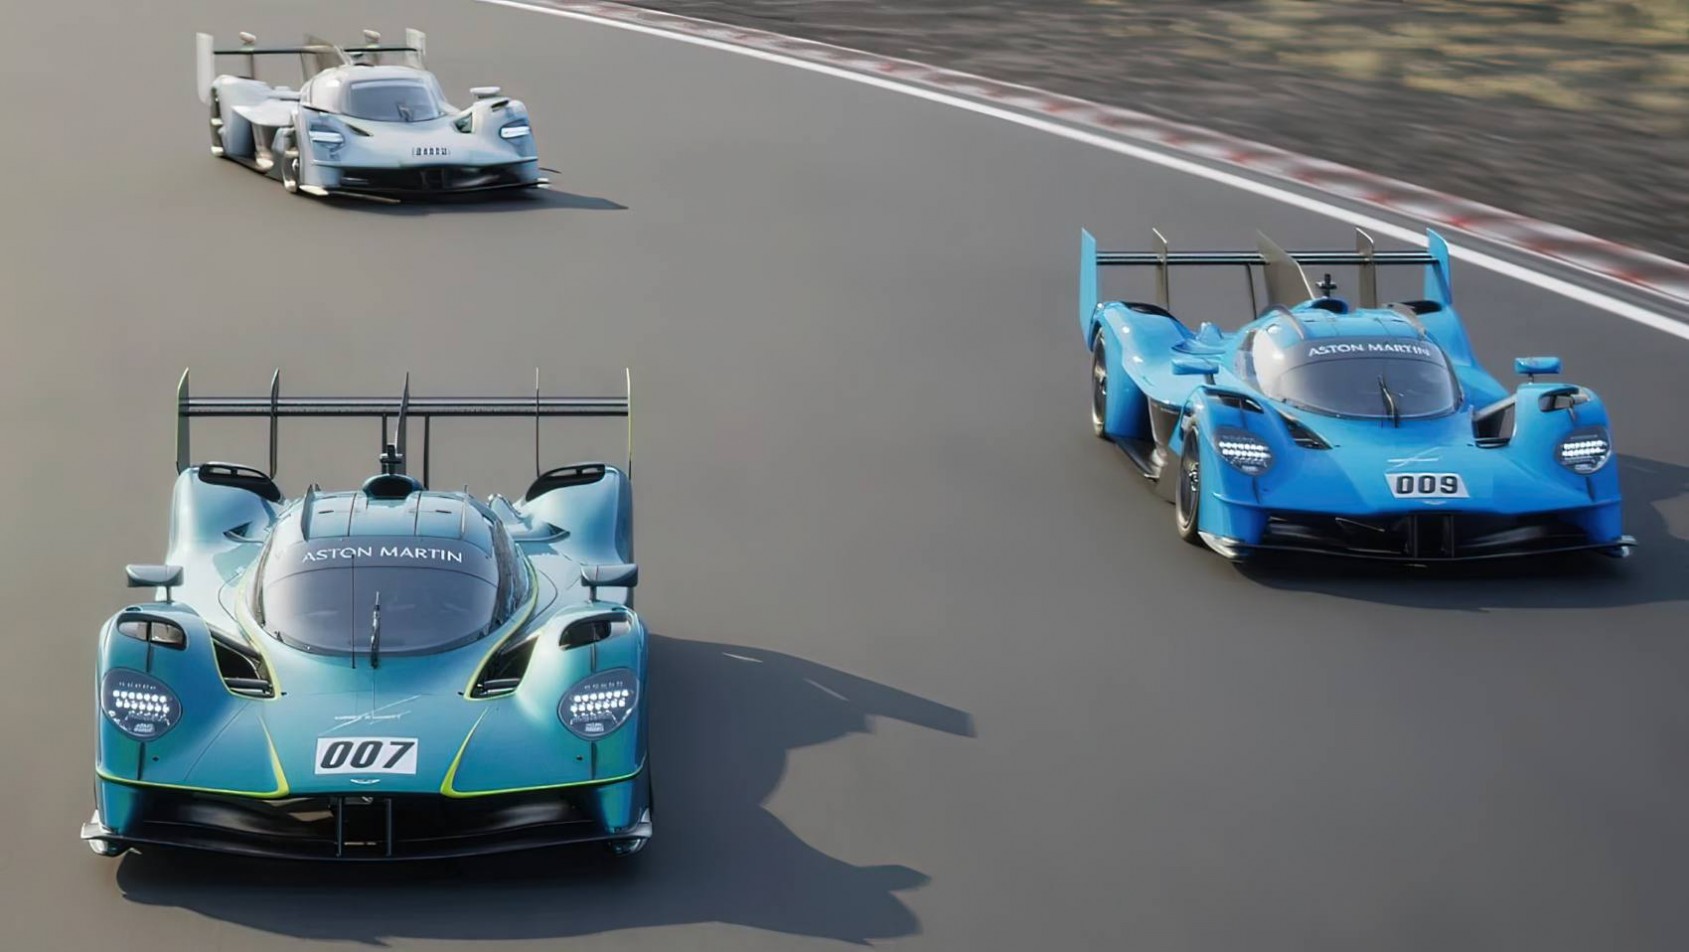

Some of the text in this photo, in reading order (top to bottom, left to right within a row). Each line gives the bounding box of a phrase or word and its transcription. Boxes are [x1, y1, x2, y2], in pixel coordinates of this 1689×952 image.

[1308, 343, 1431, 357] ASTON MARTIN
[1396, 475, 1458, 495] 009
[302, 546, 463, 563] ASTON MARTIN
[320, 741, 415, 769] 007
